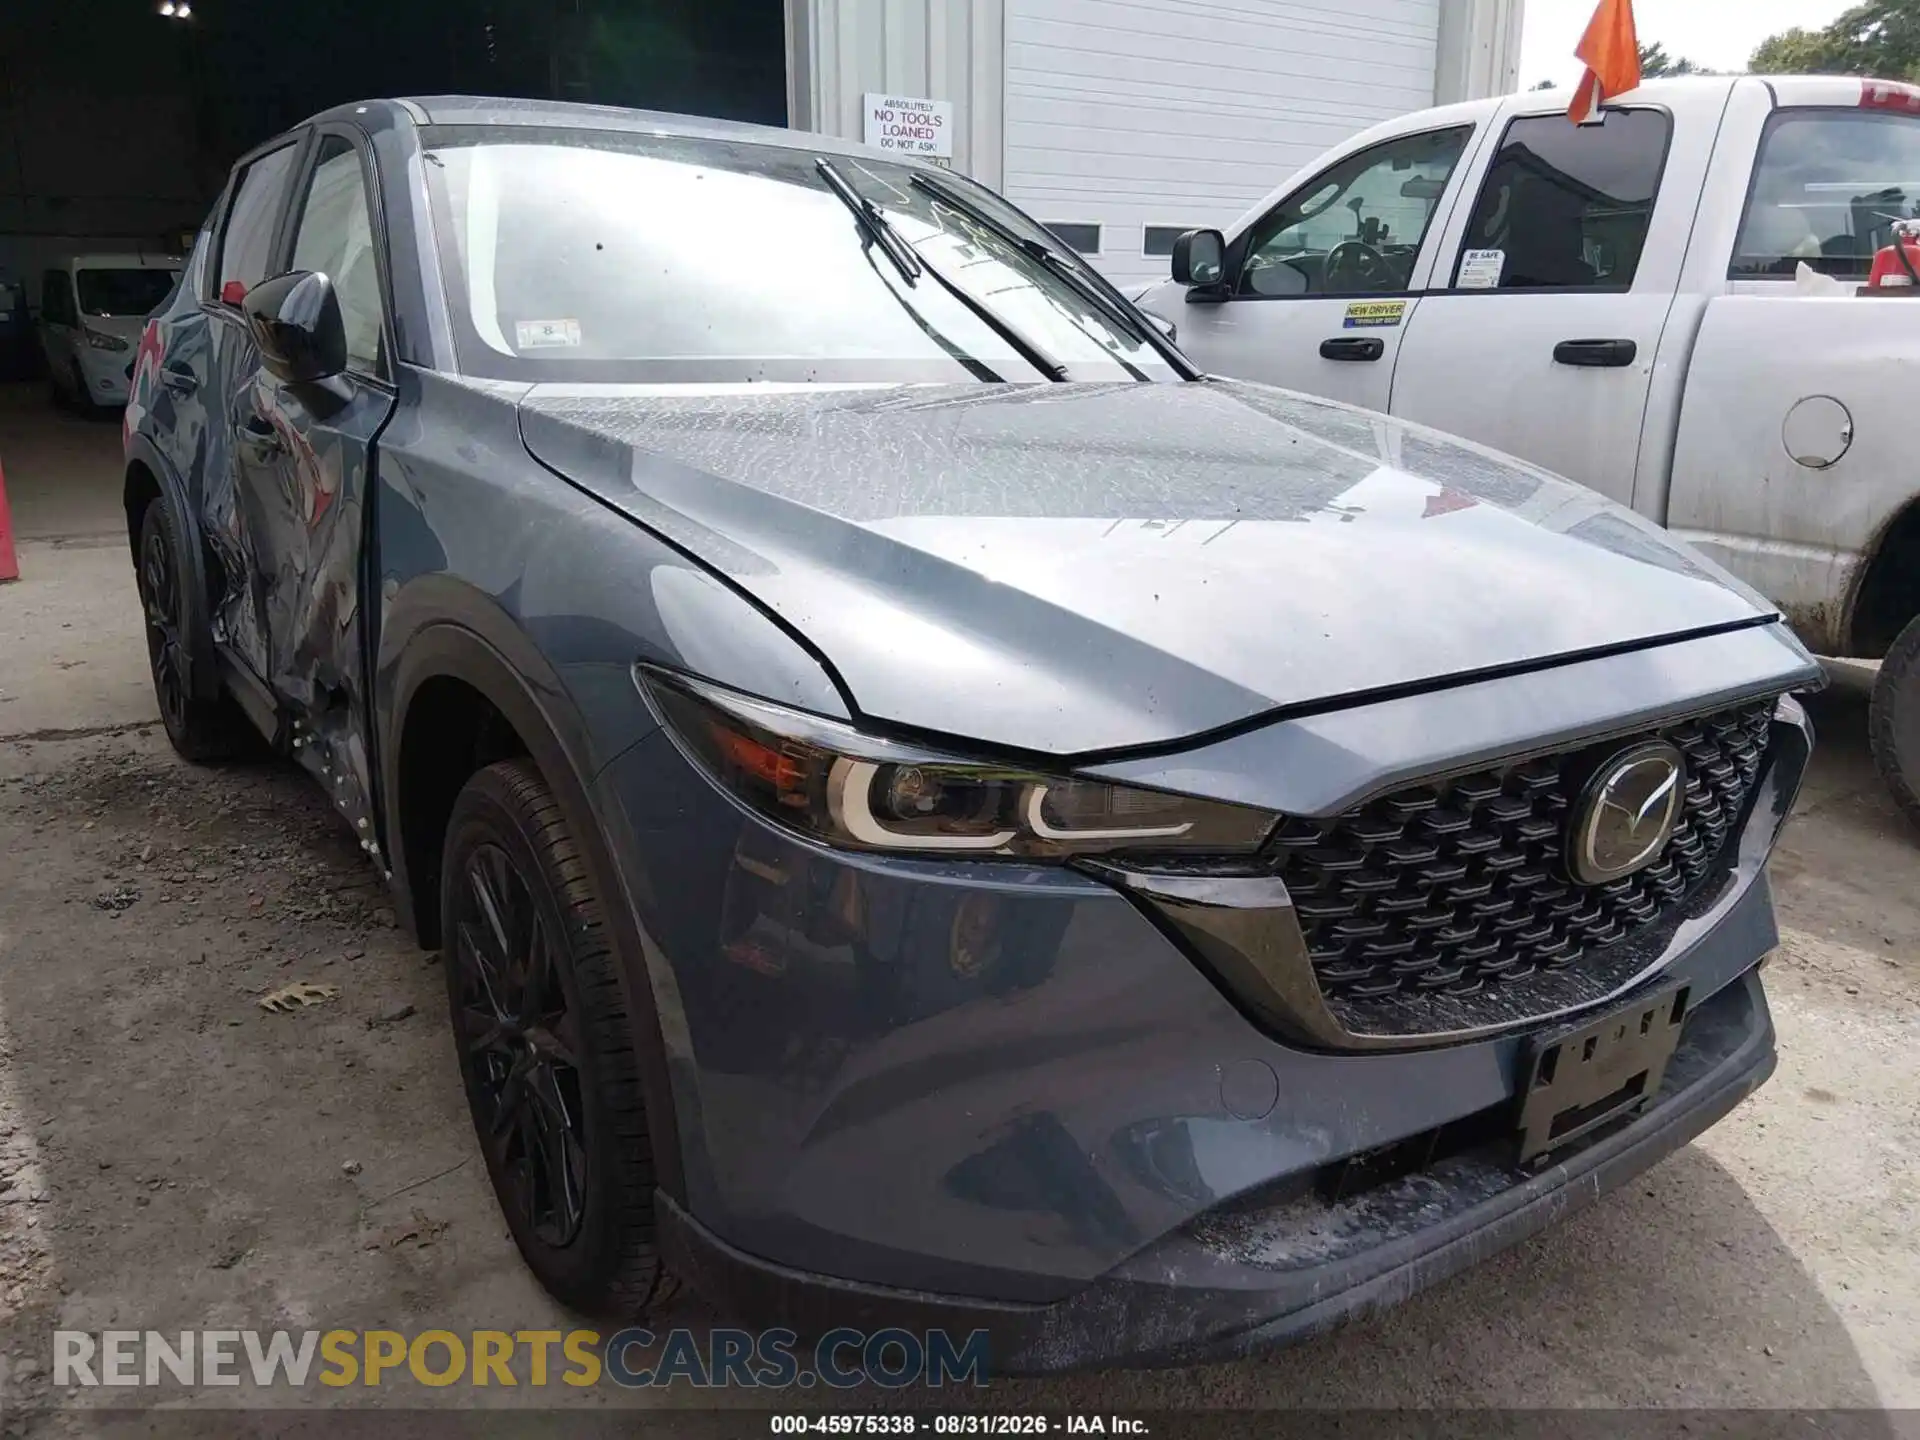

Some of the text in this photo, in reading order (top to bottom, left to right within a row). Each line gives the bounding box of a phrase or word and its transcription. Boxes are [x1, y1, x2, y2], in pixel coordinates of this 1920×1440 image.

[884, 99, 934, 112] ABSOLUTELY
[874, 109, 942, 127] NO TOOLS
[882, 125, 934, 140] LOANED
[880, 138, 894, 148] DO
[897, 140, 914, 149] NOT
[1346, 303, 1405, 315] NEW DRIVER
